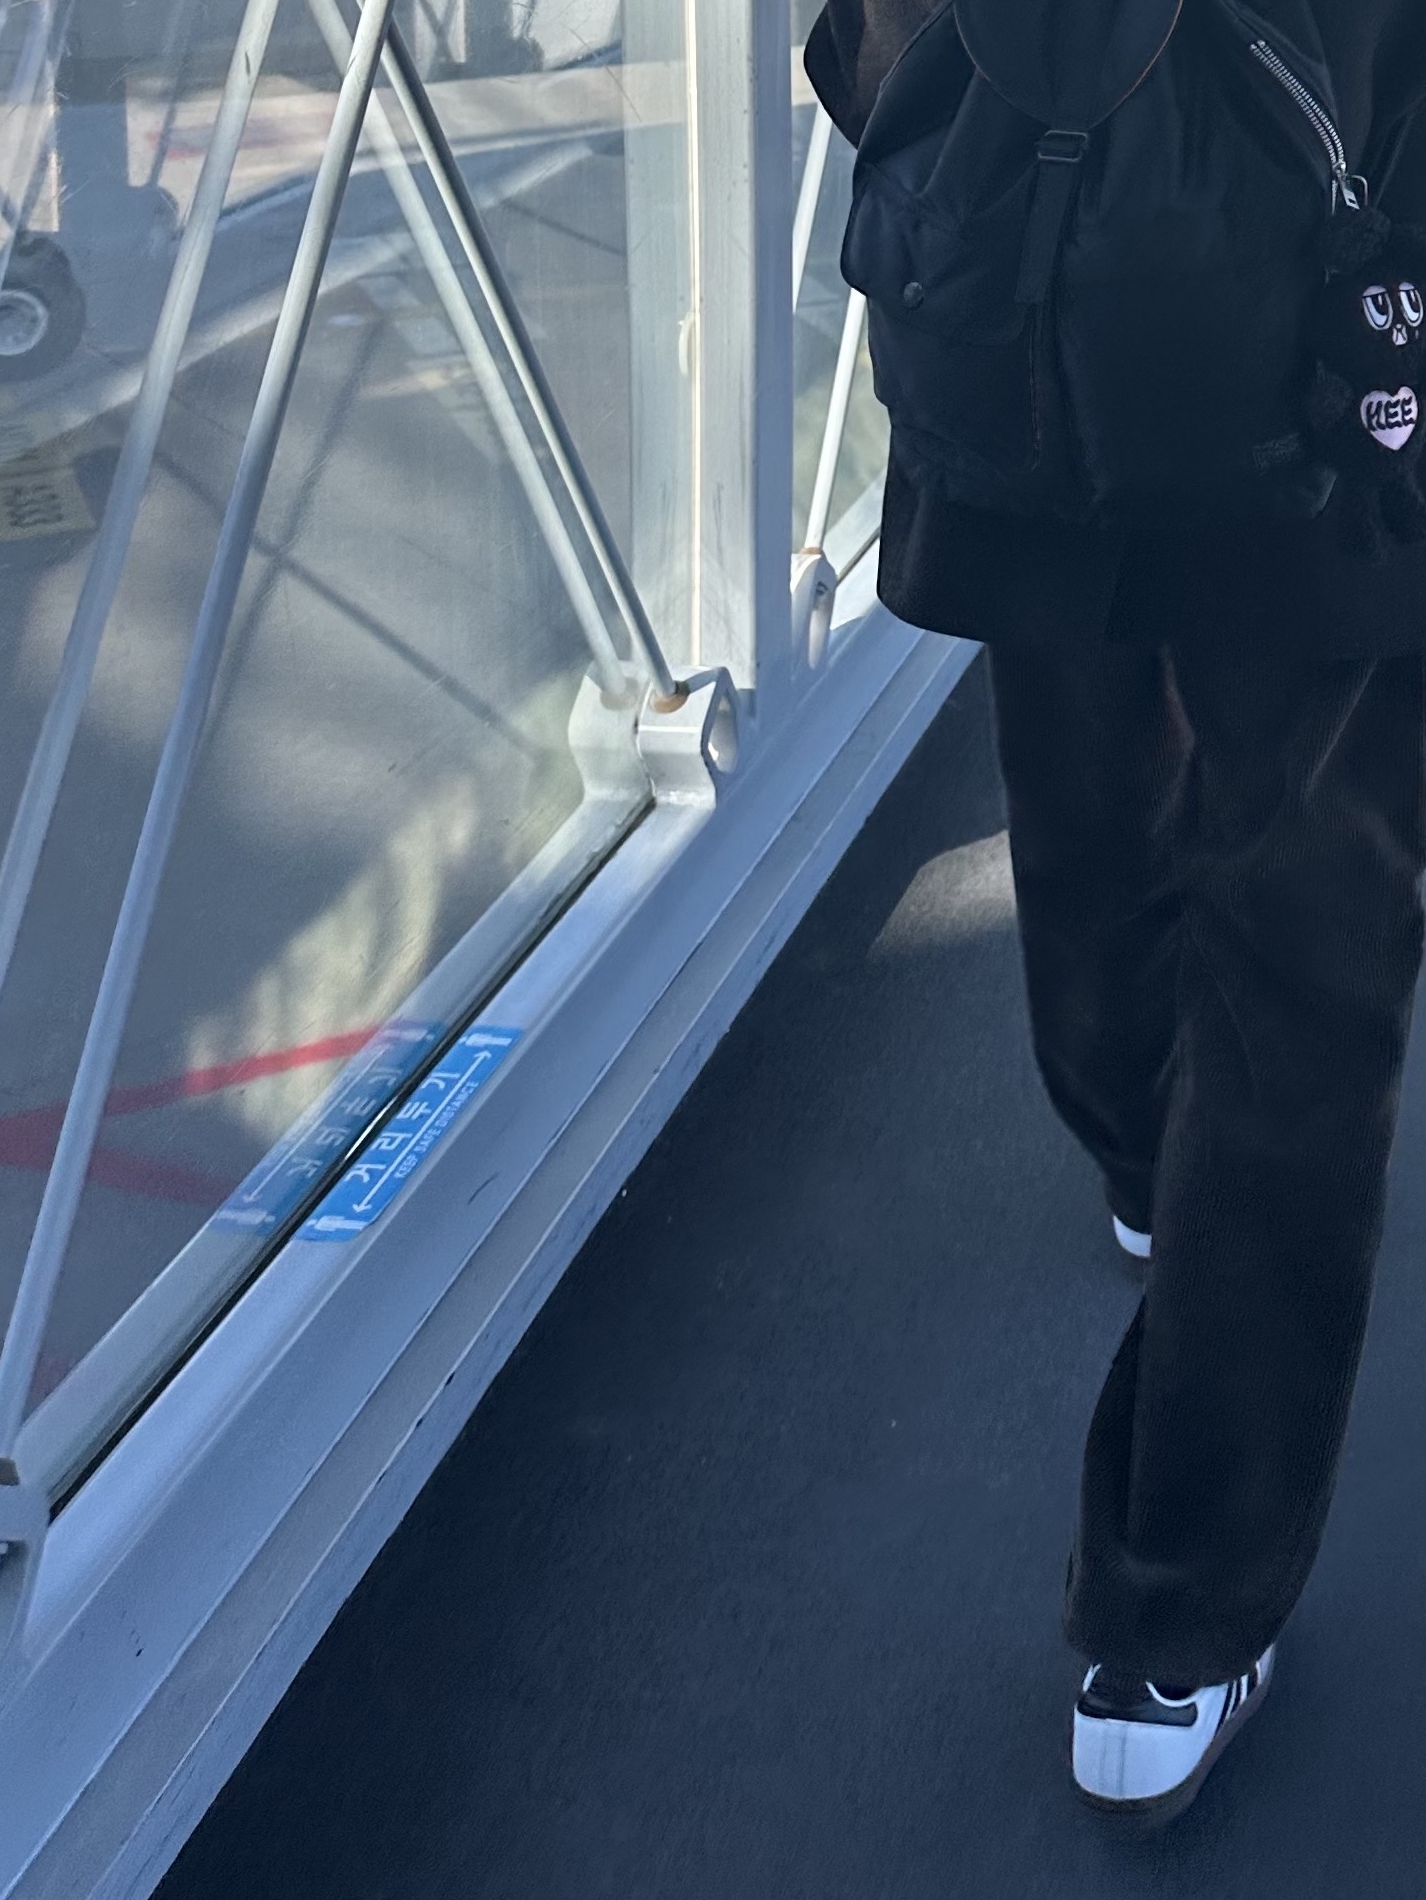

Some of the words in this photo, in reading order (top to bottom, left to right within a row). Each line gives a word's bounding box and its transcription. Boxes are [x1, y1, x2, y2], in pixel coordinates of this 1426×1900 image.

[1366, 396, 1416, 432] HEE
[344, 1071, 461, 1183] 거리두기
[414, 1128, 441, 1154] SAFE
[435, 1081, 479, 1128] DISTANCE
